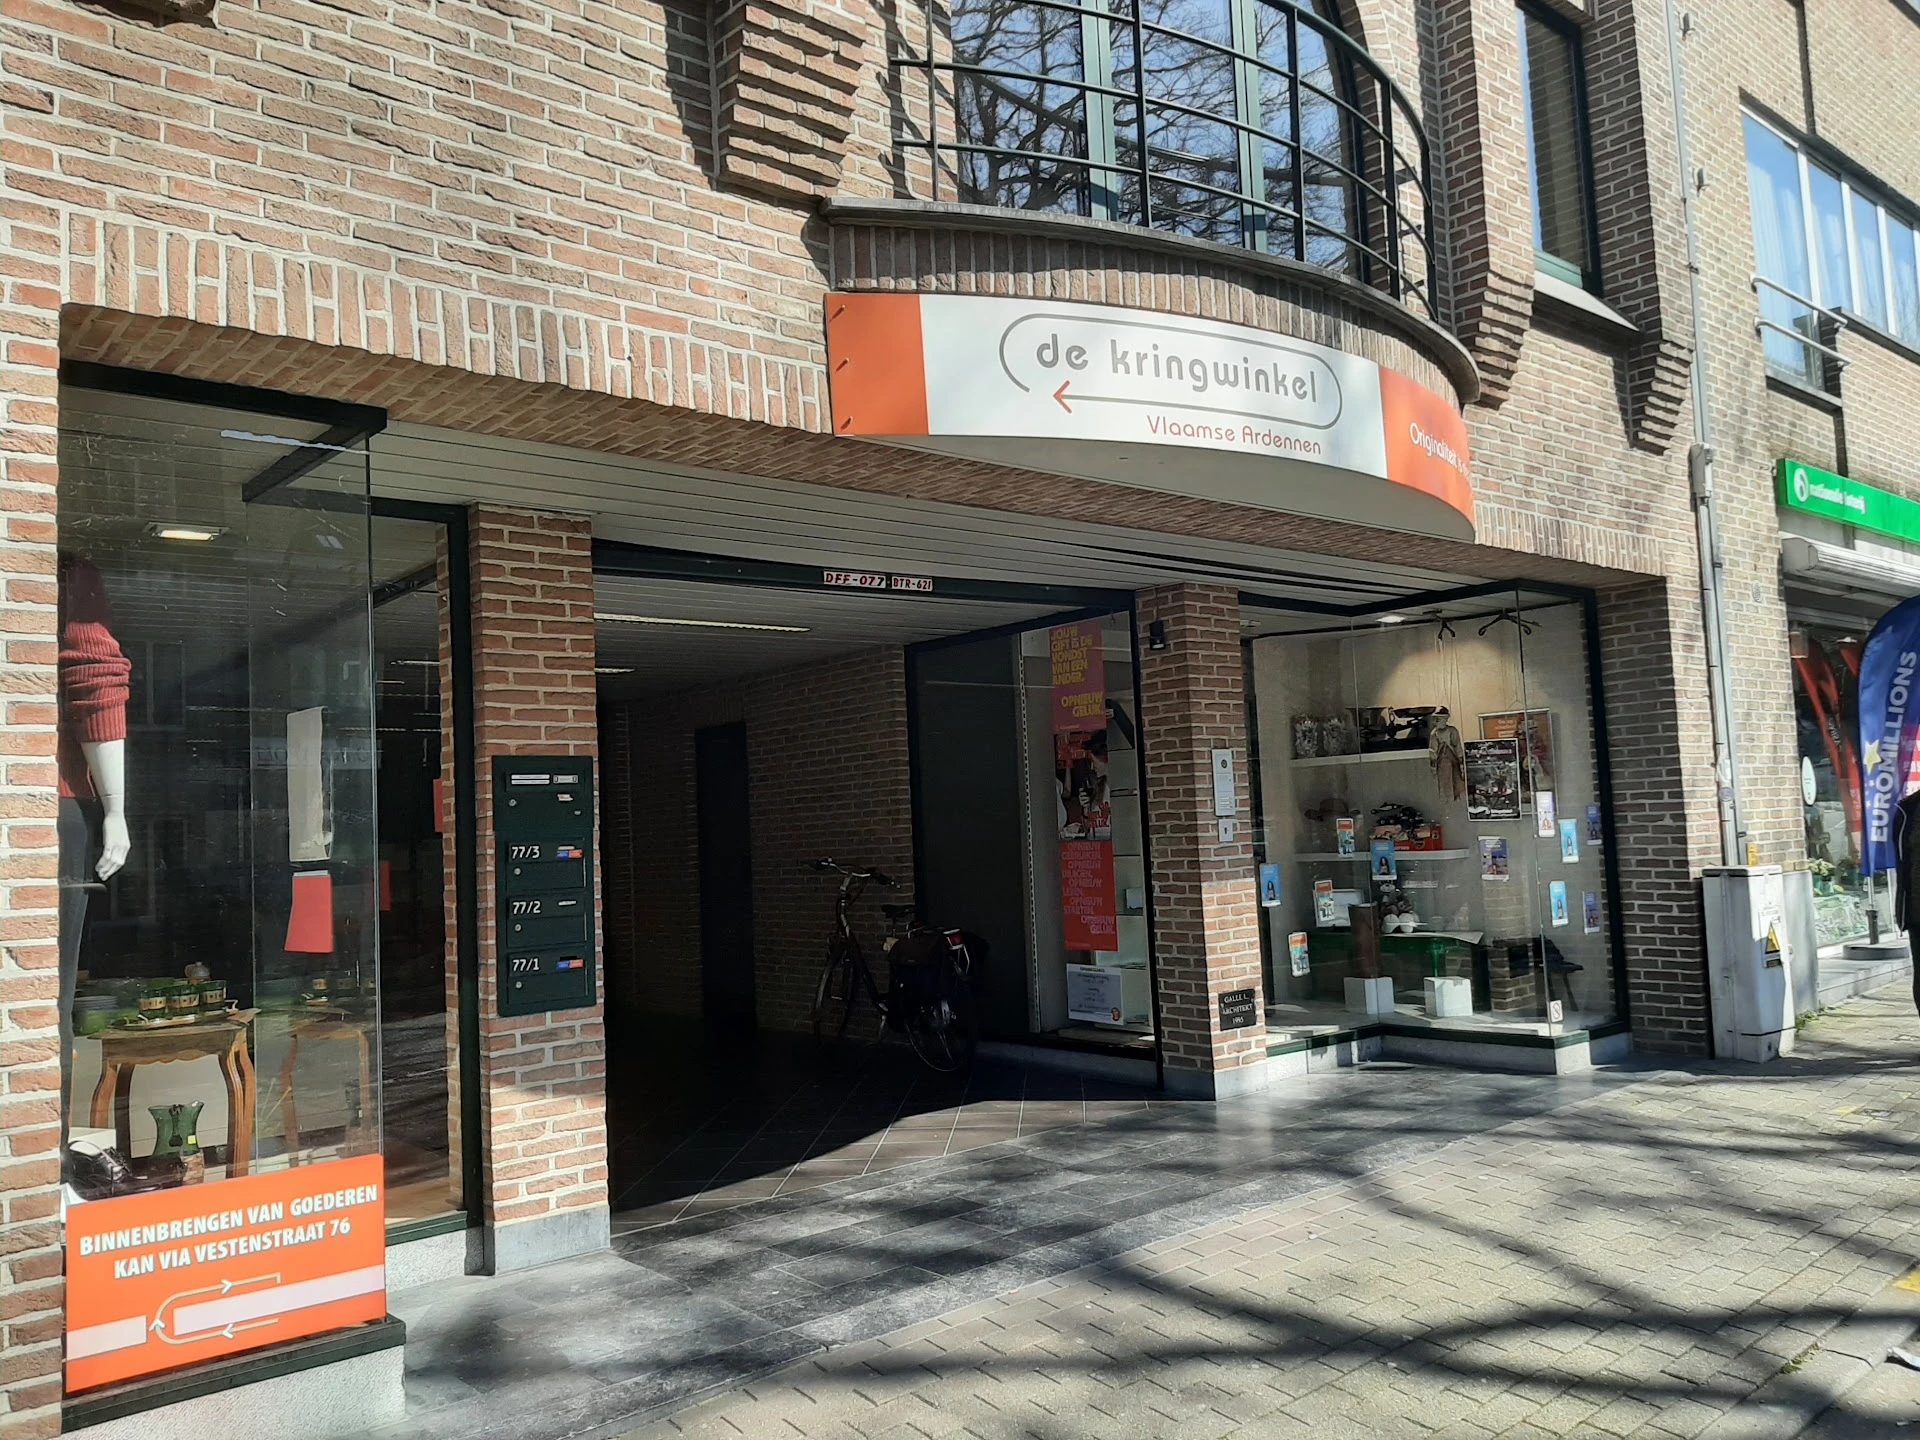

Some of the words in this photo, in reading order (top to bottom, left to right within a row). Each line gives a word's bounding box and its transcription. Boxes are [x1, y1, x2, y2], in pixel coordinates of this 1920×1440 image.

[1036, 333, 1088, 371] de
[1110, 338, 1317, 403] kringwinkel
[1146, 414, 1236, 442] Vlaamse
[1241, 425, 1322, 456] Ardennen
[825, 572, 885, 587] DFF-077
[893, 577, 931, 590] BTR-621
[1051, 625, 1079, 641] JOUW
[1052, 647, 1088, 663] VONDST
[1061, 691, 1103, 707] OPNIEUW
[1870, 651, 1917, 842] EUROMILLIONS
[511, 845, 541, 860] 77/3
[512, 900, 541, 914] 77/2
[512, 957, 540, 972] 77/1
[79, 1211, 244, 1257] BINNENBRENGEN
[247, 1201, 284, 1225] VAN
[290, 1184, 379, 1217] GOEDEREN
[113, 1254, 155, 1280] KAN
[158, 1246, 192, 1270] VIA
[194, 1221, 326, 1264] VESTENSTRAAT
[328, 1216, 352, 1239] 76
